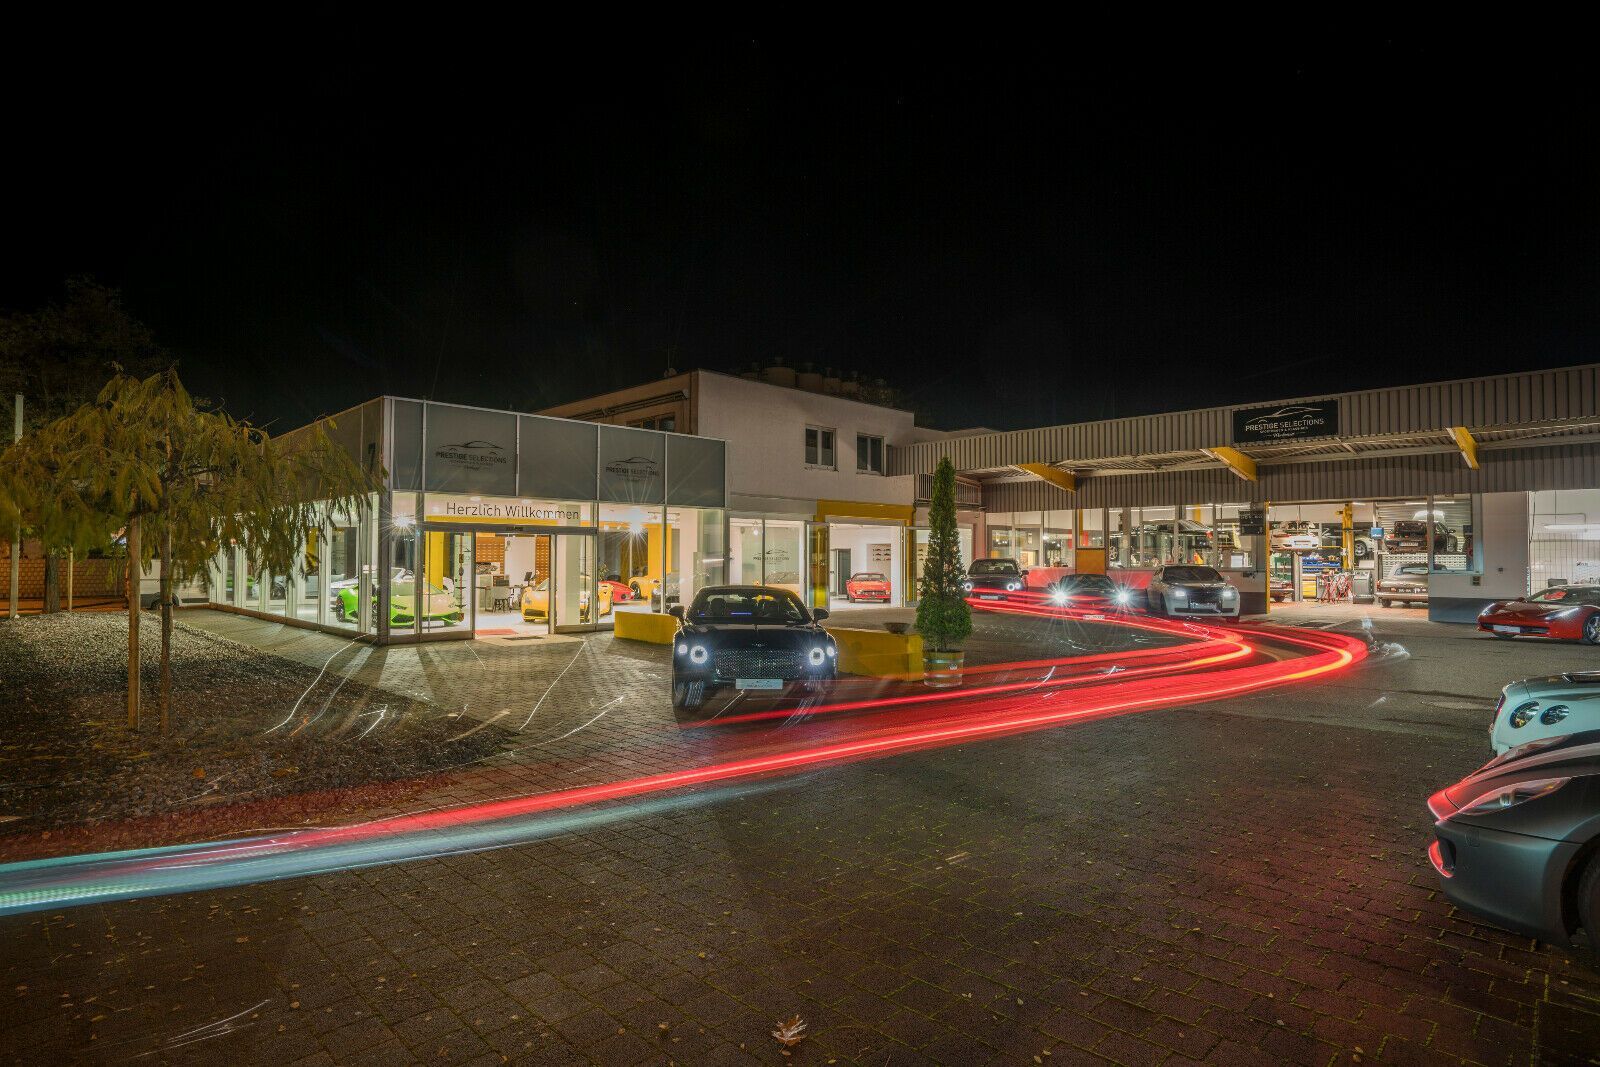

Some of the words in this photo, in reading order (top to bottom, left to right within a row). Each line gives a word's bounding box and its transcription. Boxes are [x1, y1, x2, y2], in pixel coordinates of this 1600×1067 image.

[1245, 422, 1279, 431] PRESTIGE
[1279, 418, 1324, 428] SELECTIONS
[436, 451, 468, 460] PRESTIGE
[446, 502, 501, 517] Herzlich
[505, 505, 580, 520] Willkommen
